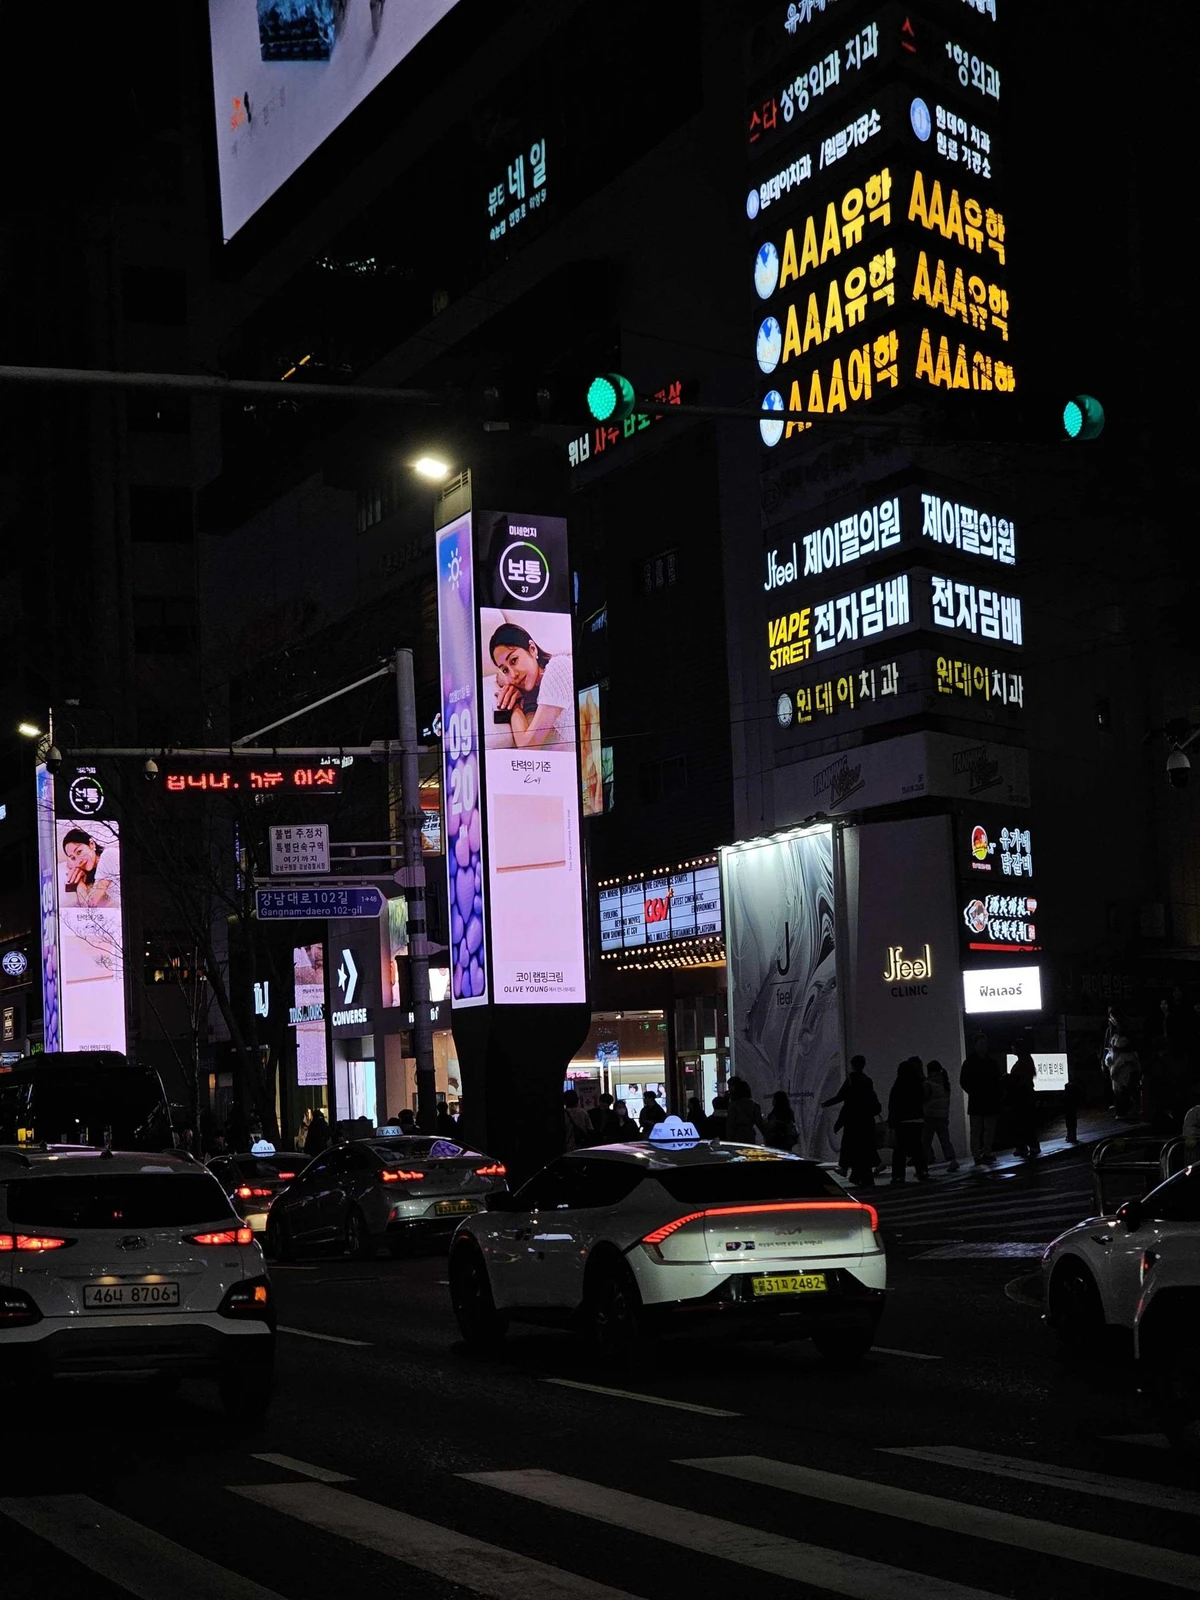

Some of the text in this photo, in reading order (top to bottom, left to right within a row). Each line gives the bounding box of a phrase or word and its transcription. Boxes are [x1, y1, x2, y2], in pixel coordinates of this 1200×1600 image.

[751, 22, 879, 142] 스타 성형외과 치과
[936, 105, 990, 155] 원데이 치과
[508, 138, 547, 201] 네일
[760, 154, 811, 210] 원데이치과
[780, 167, 893, 289] AAA유학
[908, 170, 1006, 265] AAA유학
[782, 247, 897, 364] AAA유학
[912, 250, 1010, 341] AAA유학
[785, 329, 899, 439] AAA어학
[568, 432, 591, 468] 위너
[802, 497, 901, 577] 제이필의원
[921, 493, 1016, 566] 제이필의원
[508, 558, 542, 584] 보통
[521, 586, 530, 594] 37
[814, 574, 910, 652] 전자담배
[931, 576, 1023, 646] 전자담배
[768, 606, 811, 648] VAPE
[770, 638, 811, 671] STREET
[937, 656, 1024, 708] 원데이치과
[450, 708, 472, 760] 09
[293, 769, 336, 786] 이상
[511, 760, 552, 773] 탄력의 기준
[451, 764, 474, 815] 20
[275, 828, 292, 840] 불법
[275, 841, 324, 853] 특별단속구역
[1000, 827, 1031, 853] 유가네
[283, 855, 317, 863] 여기까지
[1001, 852, 1033, 877] 닭갈비
[260, 890, 348, 906] 강남대로102길
[260, 905, 362, 918] Gangnam-daero 102-gil
[644, 896, 669, 924] CGV
[882, 943, 932, 982] Jfeel
[503, 985, 524, 993] OLIVE
[516, 972, 532, 983] 코이
[891, 985, 928, 997] CLINIC
[979, 982, 1022, 997] ฟิลเลอร์
[776, 987, 793, 1006] feel
[332, 1008, 368, 1026] CONVERSE
[669, 1127, 693, 1137] TAXI
[131, 1286, 171, 1302] 8706
[790, 1276, 822, 1291] 2482
